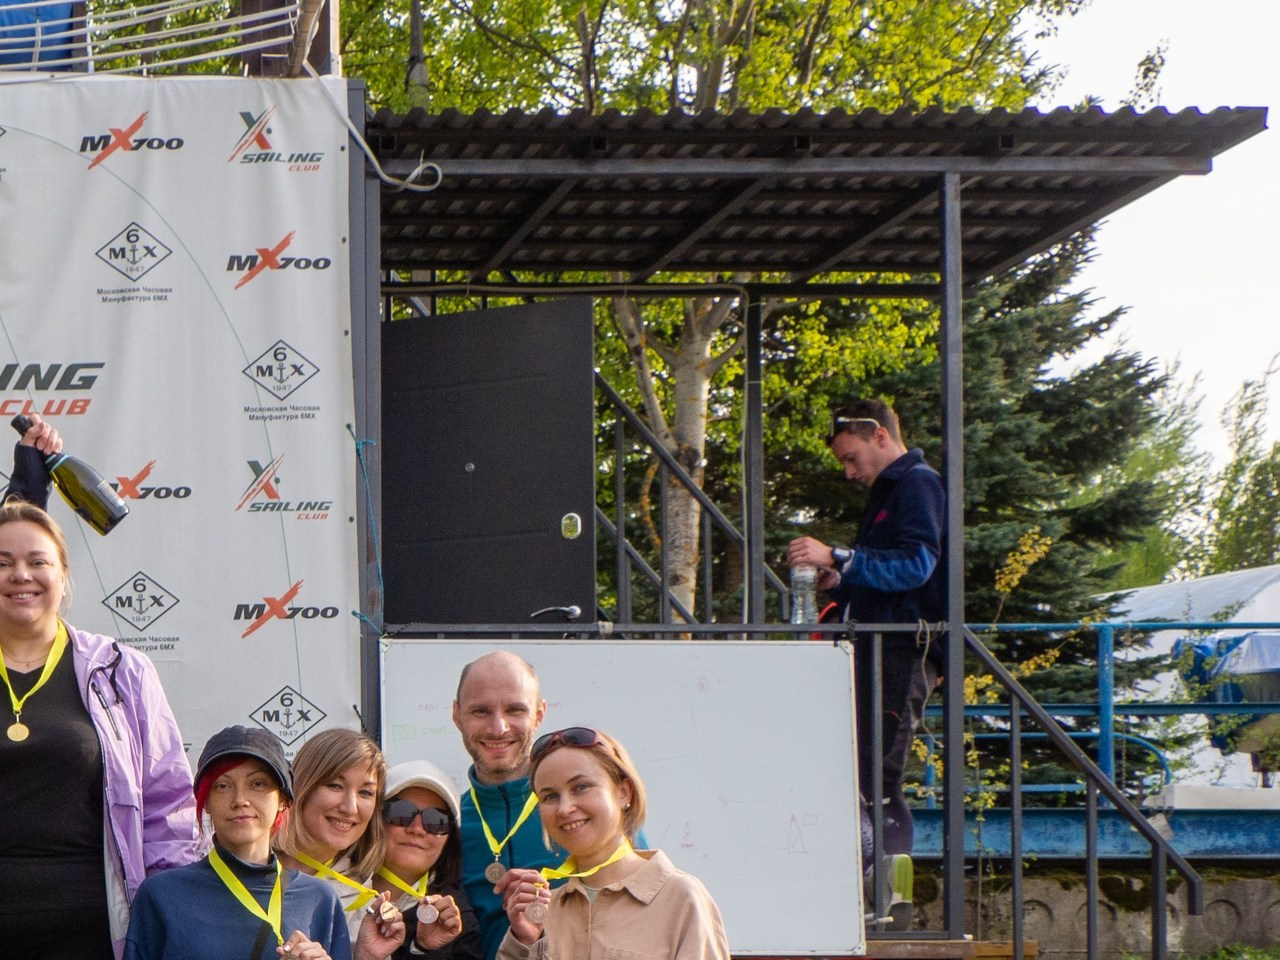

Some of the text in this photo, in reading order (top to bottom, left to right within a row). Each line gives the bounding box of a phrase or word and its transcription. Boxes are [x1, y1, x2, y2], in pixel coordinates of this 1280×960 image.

[79, 110, 184, 170] MX700
[241, 152, 324, 163] SAILING
[288, 164, 320, 172] CLUB
[126, 229, 139, 244] 6
[226, 230, 331, 290] MX700
[96, 287, 140, 295] Московская
[101, 295, 151, 304] Мануфактура
[273, 347, 287, 362] 6
[243, 404, 321, 413] Московская Часовая
[248, 413, 299, 423] Мануфактура
[109, 459, 192, 501] X700
[248, 501, 333, 512] SAILING
[297, 512, 329, 520] CLUB
[133, 578, 146, 593] 6
[233, 578, 340, 639] MX700
[148, 635, 180, 643] Часовая
[279, 692, 293, 707] 6
